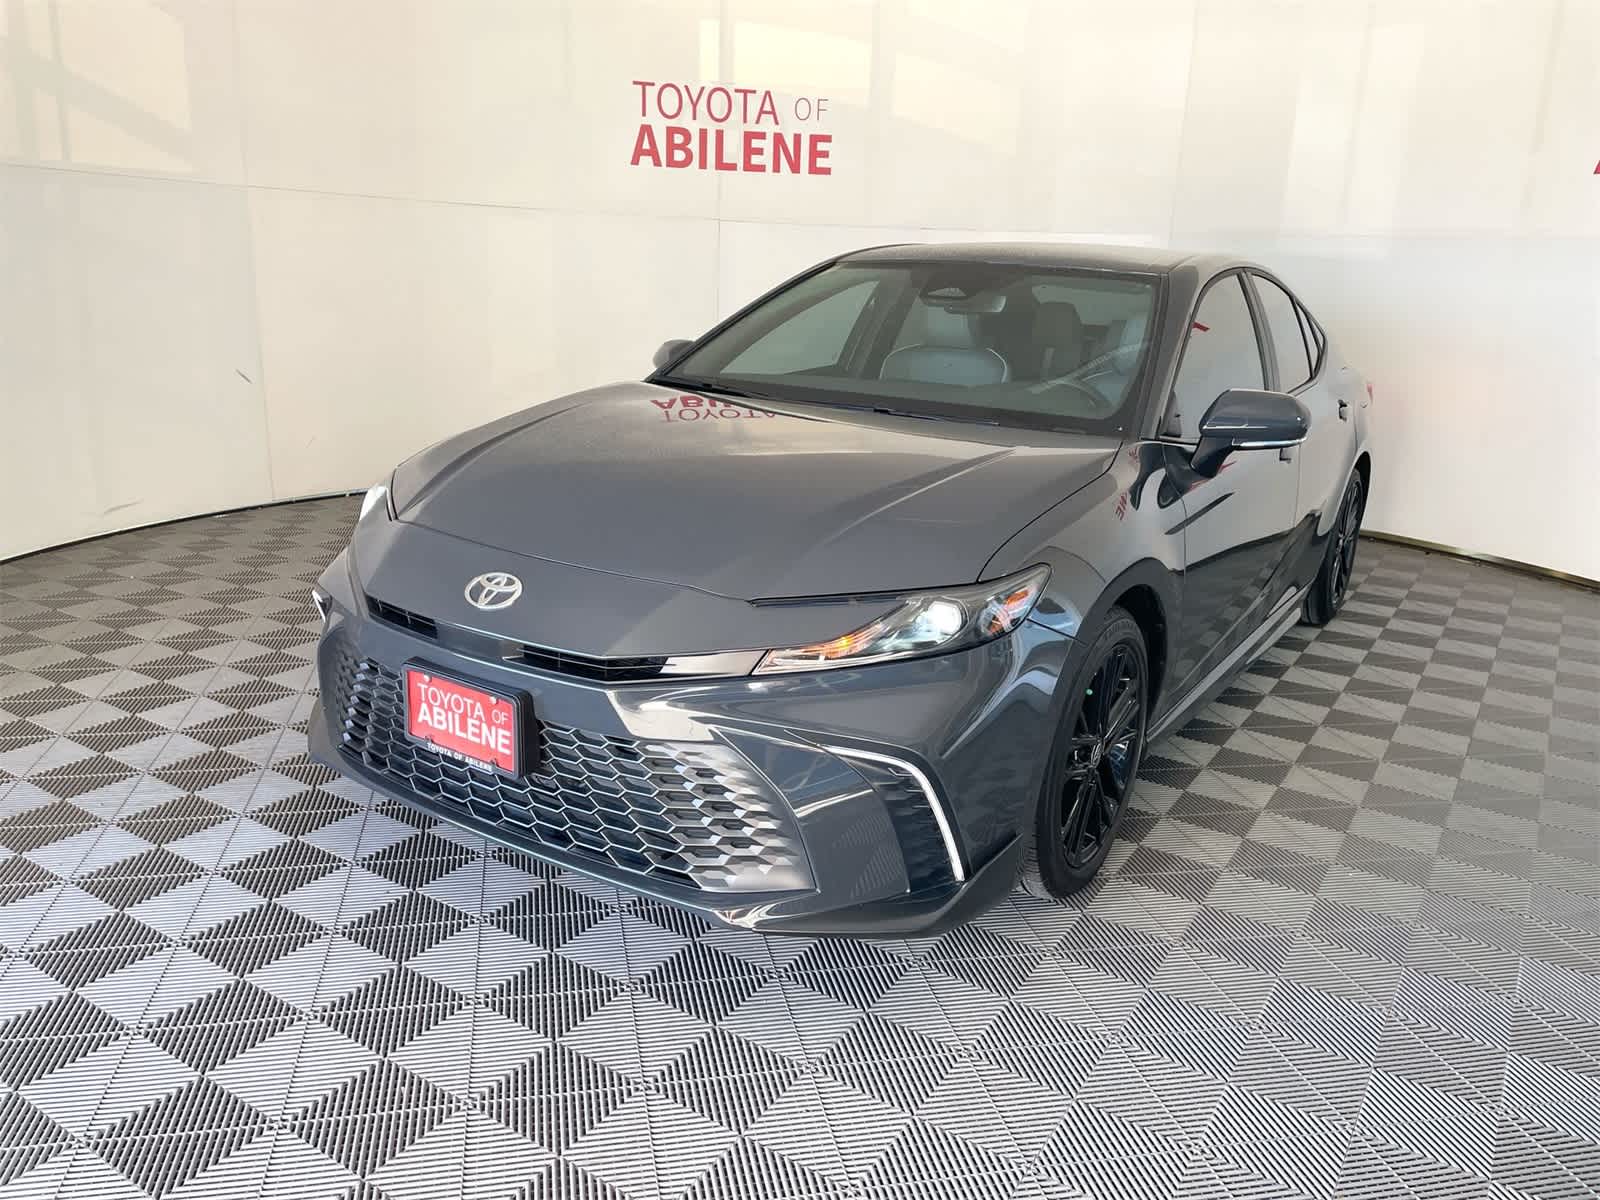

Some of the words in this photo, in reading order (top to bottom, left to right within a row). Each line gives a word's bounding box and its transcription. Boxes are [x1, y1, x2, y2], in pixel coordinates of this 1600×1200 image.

[632, 80, 779, 126] TOYOTA
[794, 96, 830, 121] OF
[630, 123, 832, 175] ABILENE
[417, 682, 486, 721] TOYOTA
[491, 709, 509, 725] OF
[417, 702, 512, 755] ABILENE
[427, 742, 452, 757] TOYOTA
[453, 752, 463, 761] OF
